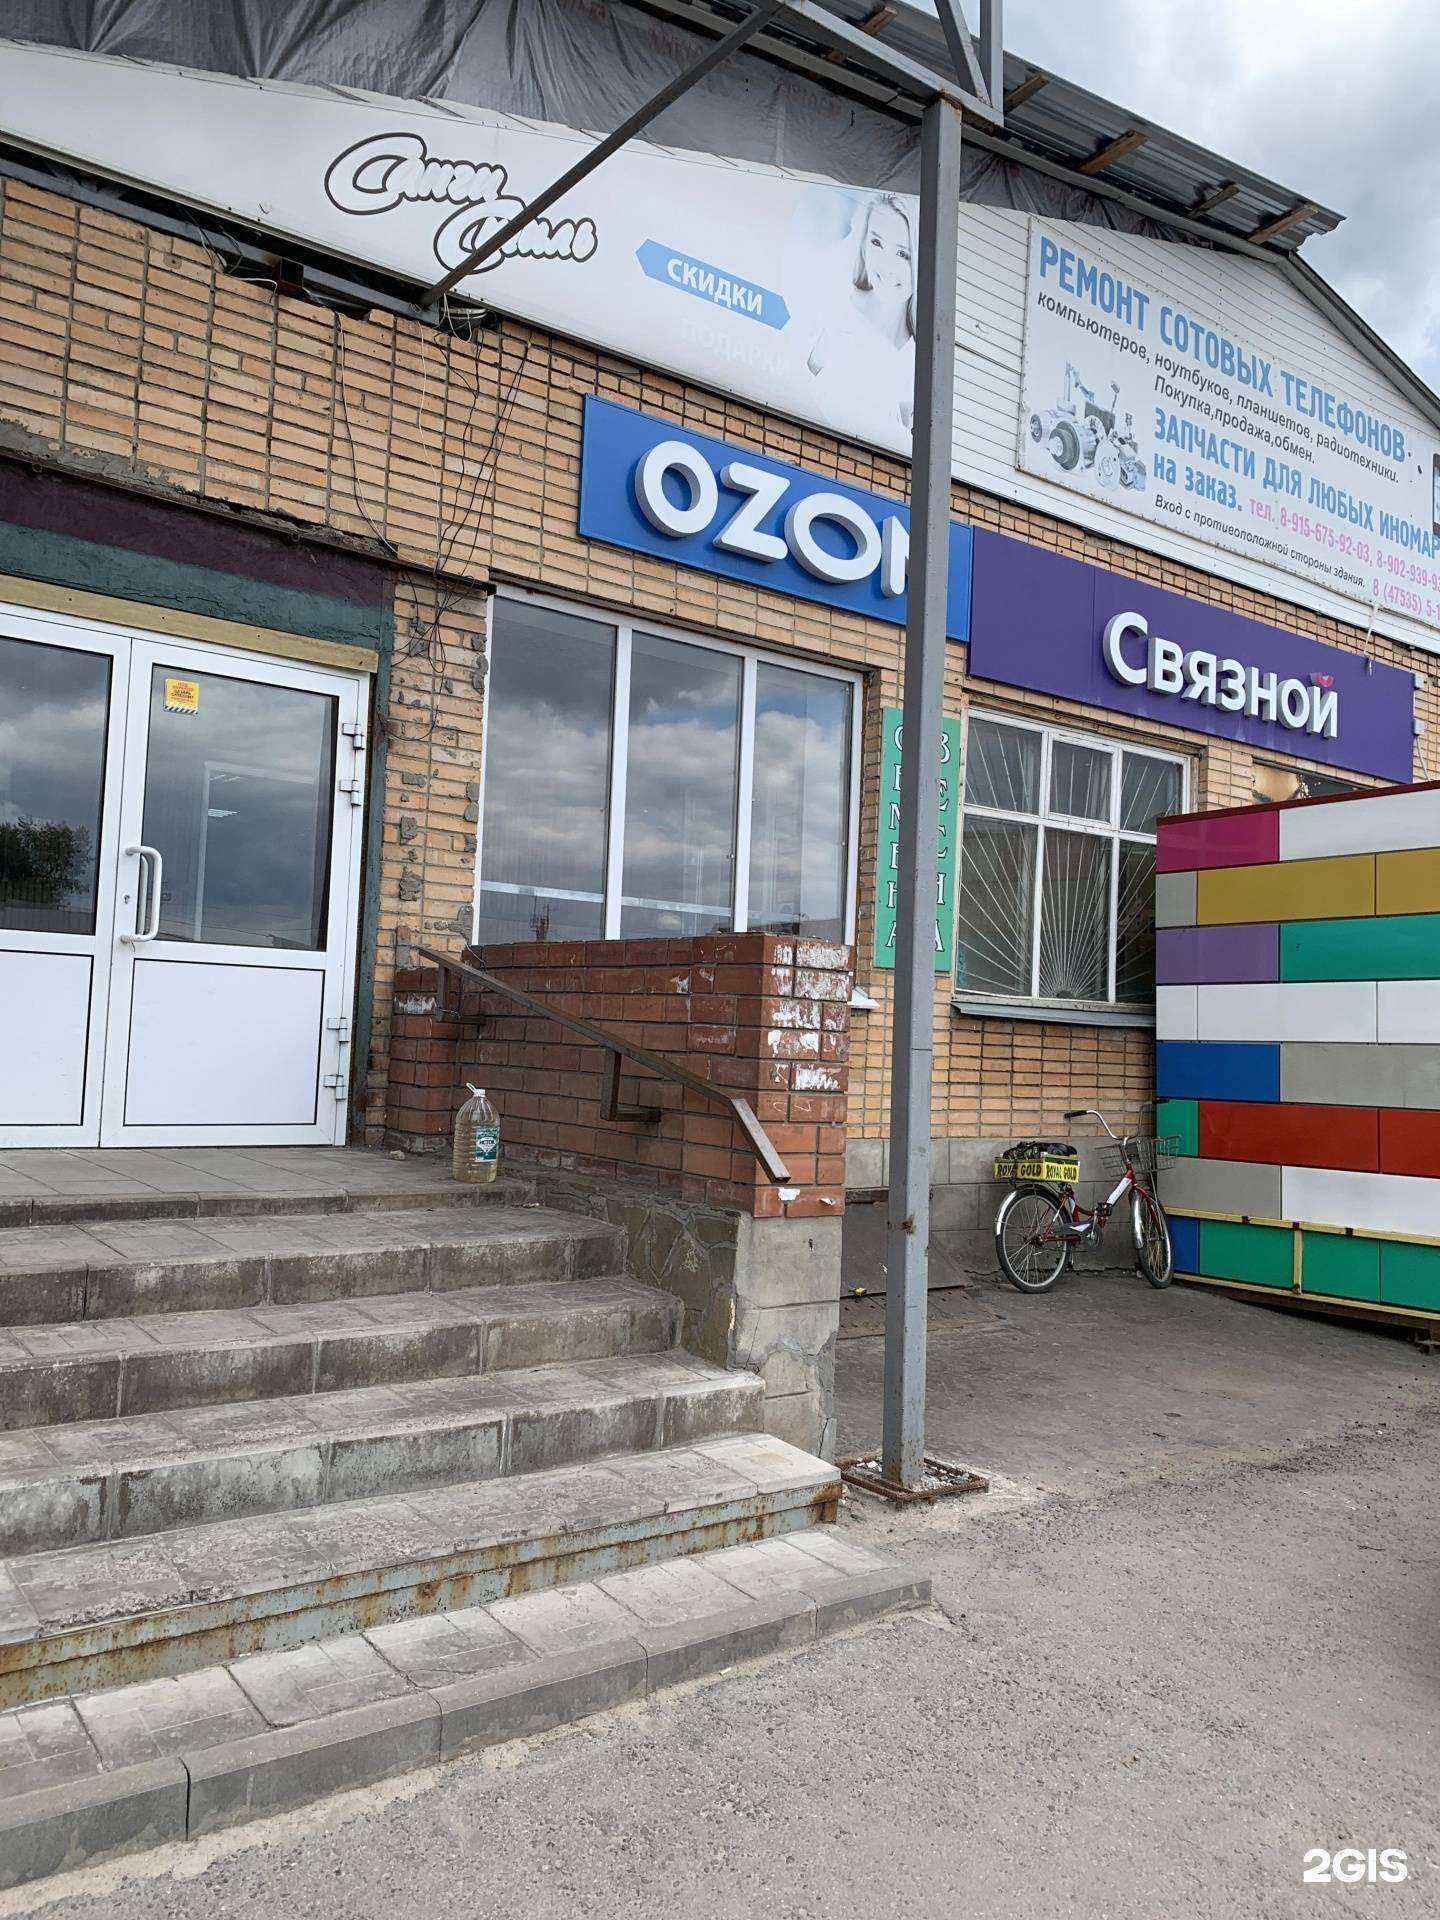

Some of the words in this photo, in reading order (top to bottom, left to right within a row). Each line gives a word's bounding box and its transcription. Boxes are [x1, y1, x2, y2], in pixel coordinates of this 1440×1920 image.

[666, 258, 764, 315] СКИДКИ
[1039, 236, 1150, 331] РЕМОНТ
[1160, 306, 1273, 397] СОТОВЫХ
[1037, 292, 1150, 364] компьютеров,
[1155, 353, 1232, 405] ноутбуков,
[1237, 394, 1313, 443] планшетов,
[1316, 433, 1399, 483] радиотехники.
[1153, 453, 1177, 485] на
[1185, 466, 1242, 511] заказ.
[1249, 498, 1275, 522] тел.
[1154, 407, 1256, 480] ЗАПЧАСТИ
[1263, 457, 1302, 498] ДЛЯ
[1308, 477, 1374, 532] ЛЮБЫХ
[1154, 494, 1183, 516] Вход
[1184, 508, 1191, 519] с
[1193, 511, 1289, 556] противоположной
[1289, 549, 1332, 576] стороны
[1372, 578, 1379, 597] 8
[1103, 611, 1338, 739] Связной
[1020, 1164, 1042, 1177] GOLD
